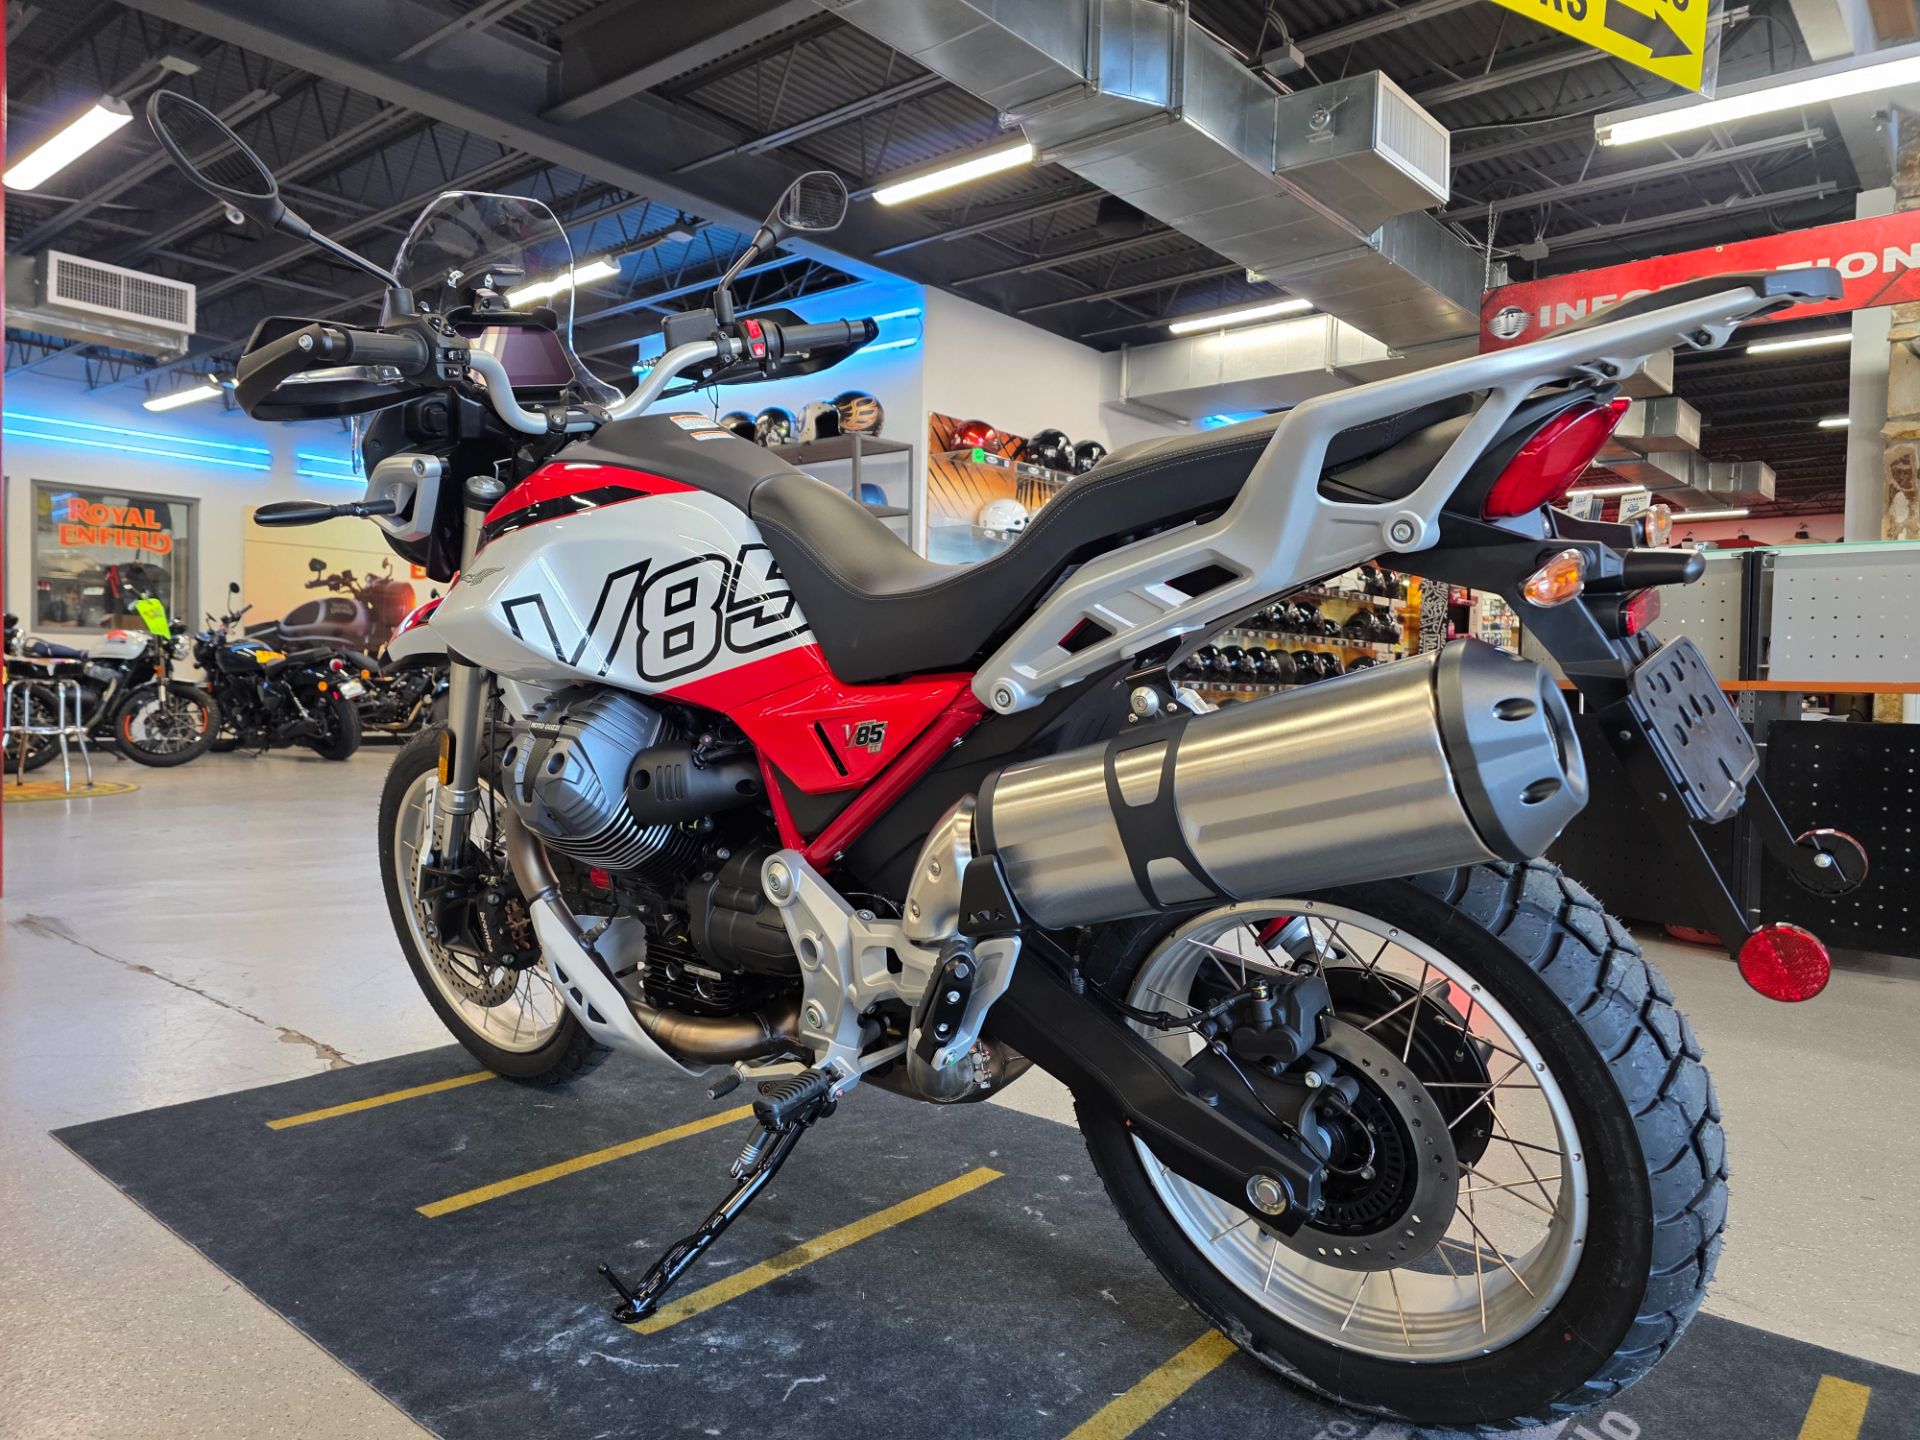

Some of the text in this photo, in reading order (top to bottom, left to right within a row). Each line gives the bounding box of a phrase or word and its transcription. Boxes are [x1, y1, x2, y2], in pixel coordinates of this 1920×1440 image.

[68, 498, 161, 529] ROYAL
[58, 524, 172, 555] ENFIELD
[500, 544, 809, 683] V85
[841, 721, 888, 749] V85
[479, 911, 493, 952] brembo
